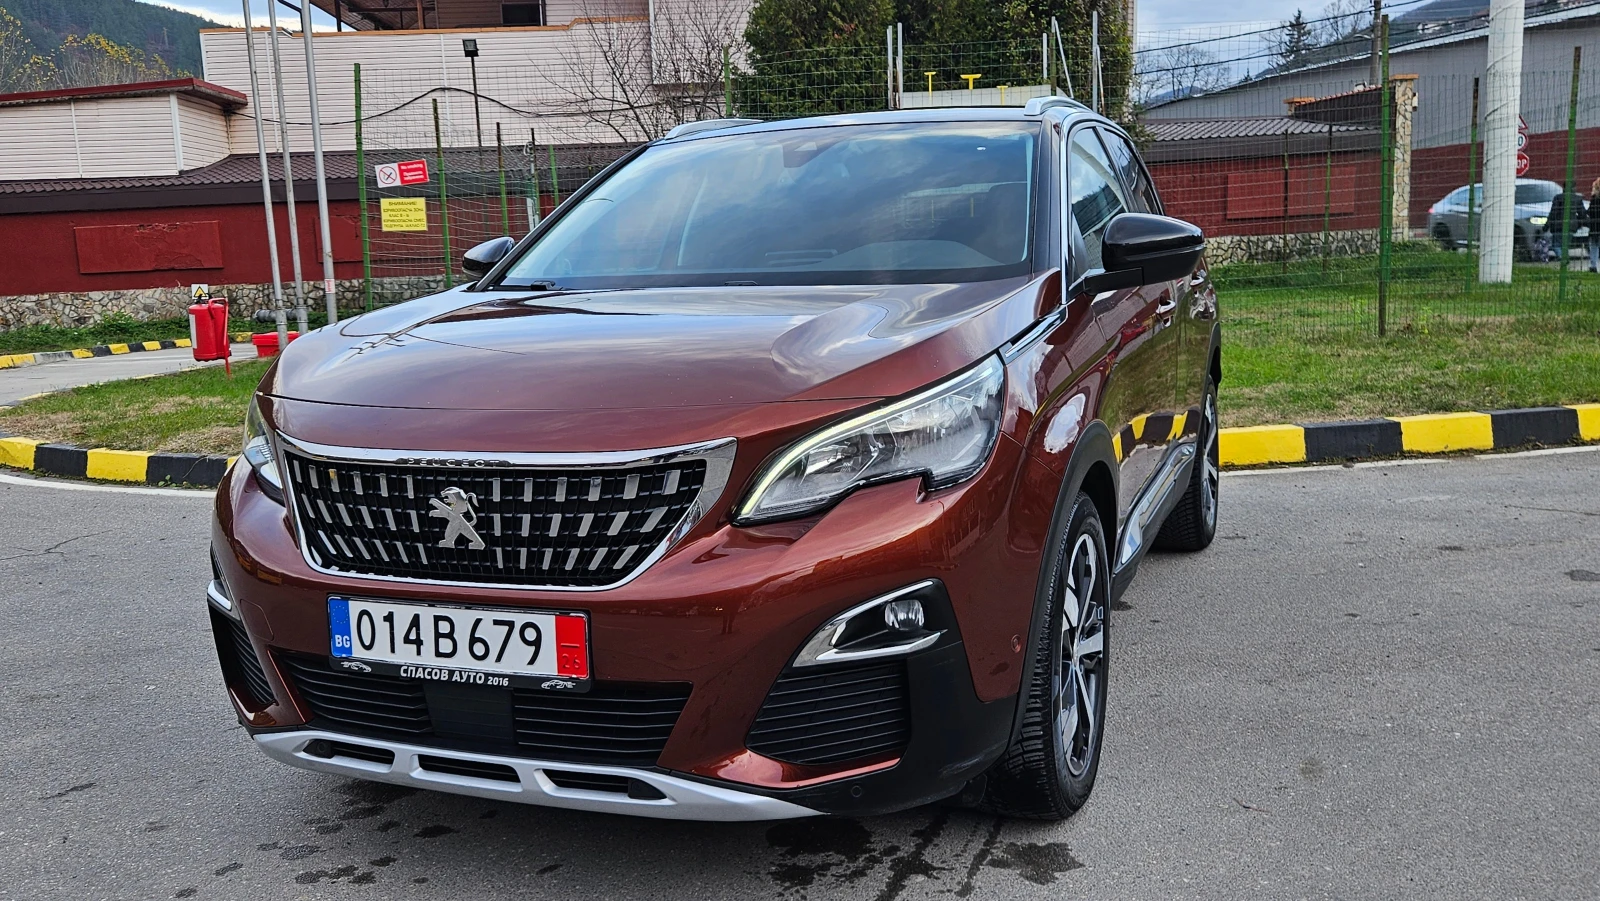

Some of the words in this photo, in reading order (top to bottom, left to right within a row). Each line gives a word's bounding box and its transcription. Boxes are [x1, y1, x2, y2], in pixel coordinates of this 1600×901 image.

[335, 634, 350, 648] BG
[562, 653, 580, 669] 26
[400, 665, 449, 681] СПАСОВ
[452, 670, 485, 684] АУТО
[487, 676, 509, 687] 2016
